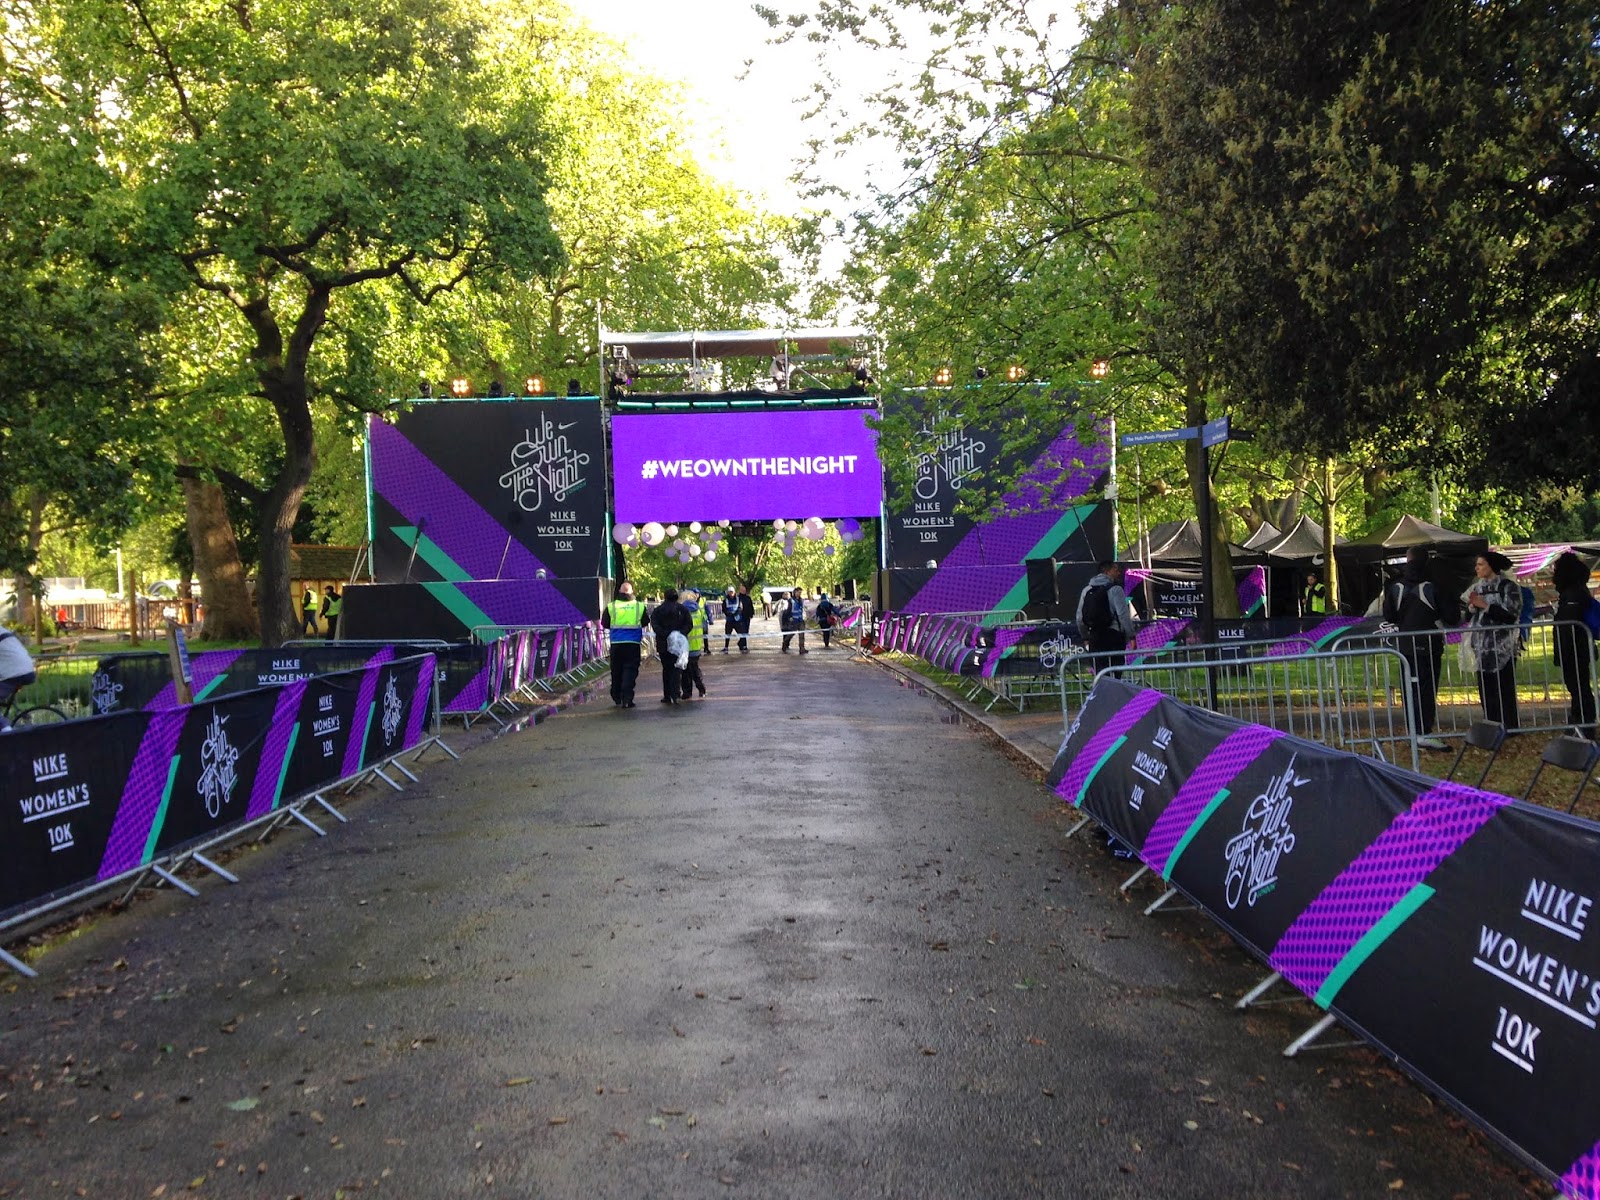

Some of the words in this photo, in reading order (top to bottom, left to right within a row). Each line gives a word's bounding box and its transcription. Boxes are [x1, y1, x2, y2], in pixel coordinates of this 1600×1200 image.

[526, 410, 553, 447] We
[511, 435, 572, 467] Run
[641, 455, 857, 479] #WEOWNTHENIGHT
[519, 450, 590, 511] Night
[550, 511, 576, 519] NIKE
[915, 502, 940, 512] NIKE
[537, 526, 590, 534] WOMEN'S
[902, 517, 954, 525] WOMEN'S
[554, 541, 573, 549] 10K
[920, 532, 938, 540] 10K
[1218, 629, 1245, 637] NIKE
[273, 659, 300, 667] NIKE
[319, 694, 332, 707] NIKE
[312, 715, 340, 732] WOMEN'S
[323, 739, 333, 752] 10K
[1155, 726, 1173, 747] NIKE
[33, 753, 68, 777] NIKE
[1135, 750, 1168, 779] WOMEN'S
[19, 783, 90, 816] WOMEN'S
[1130, 784, 1145, 805] 10K
[47, 823, 74, 846] 10K
[1524, 876, 1593, 932] NIKE
[1477, 924, 1600, 1018] WOMEN'S
[1495, 1005, 1542, 1062] 10K
